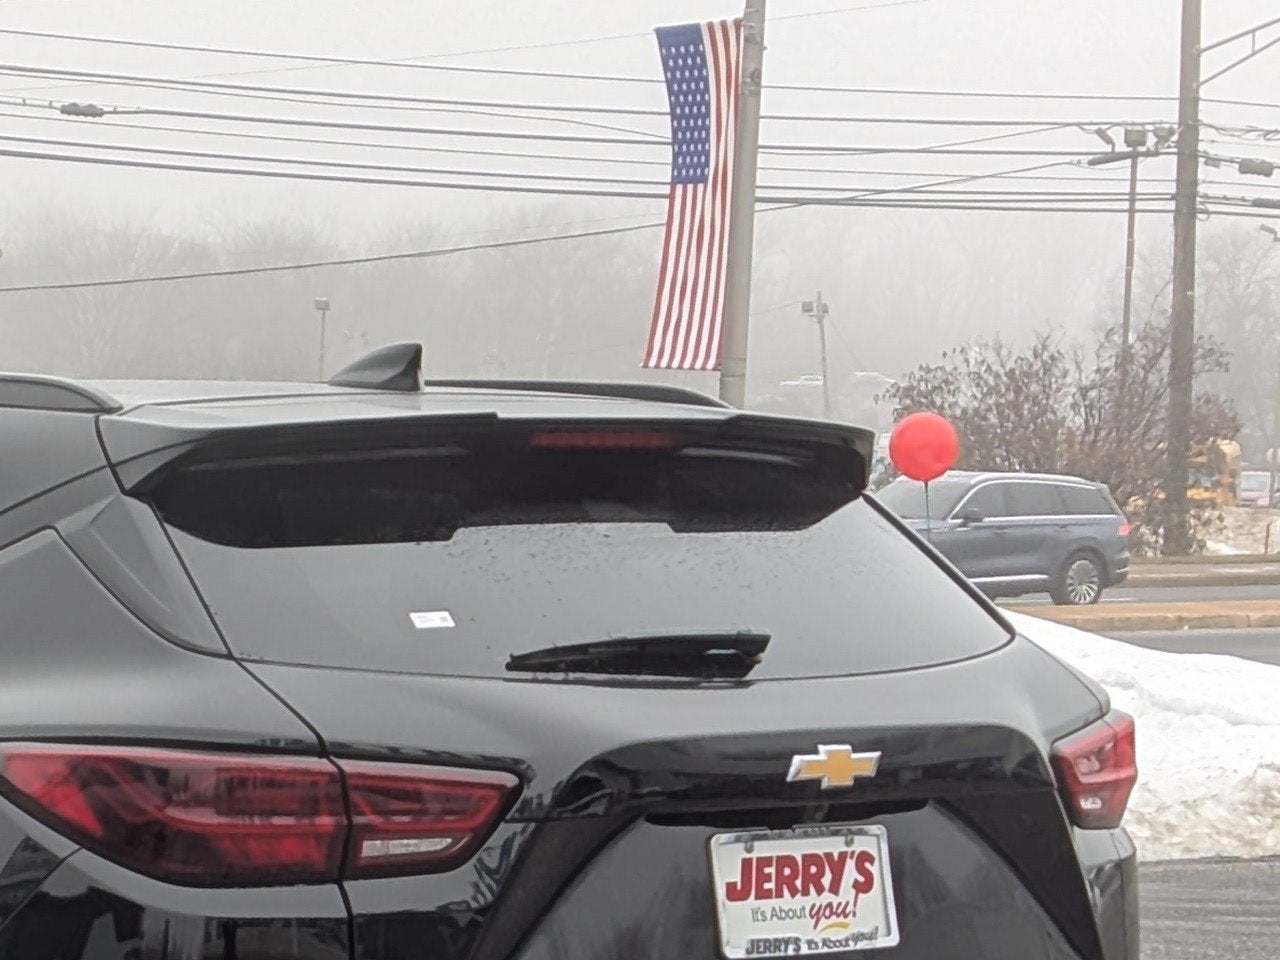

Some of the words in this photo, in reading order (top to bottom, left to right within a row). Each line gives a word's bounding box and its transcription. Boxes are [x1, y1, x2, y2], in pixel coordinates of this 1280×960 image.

[725, 850, 876, 902] JERRY'S
[752, 907, 768, 923] It's
[770, 905, 807, 921] About
[809, 891, 858, 931] you!
[745, 936, 802, 955] JERRY'S
[821, 935, 851, 950] About
